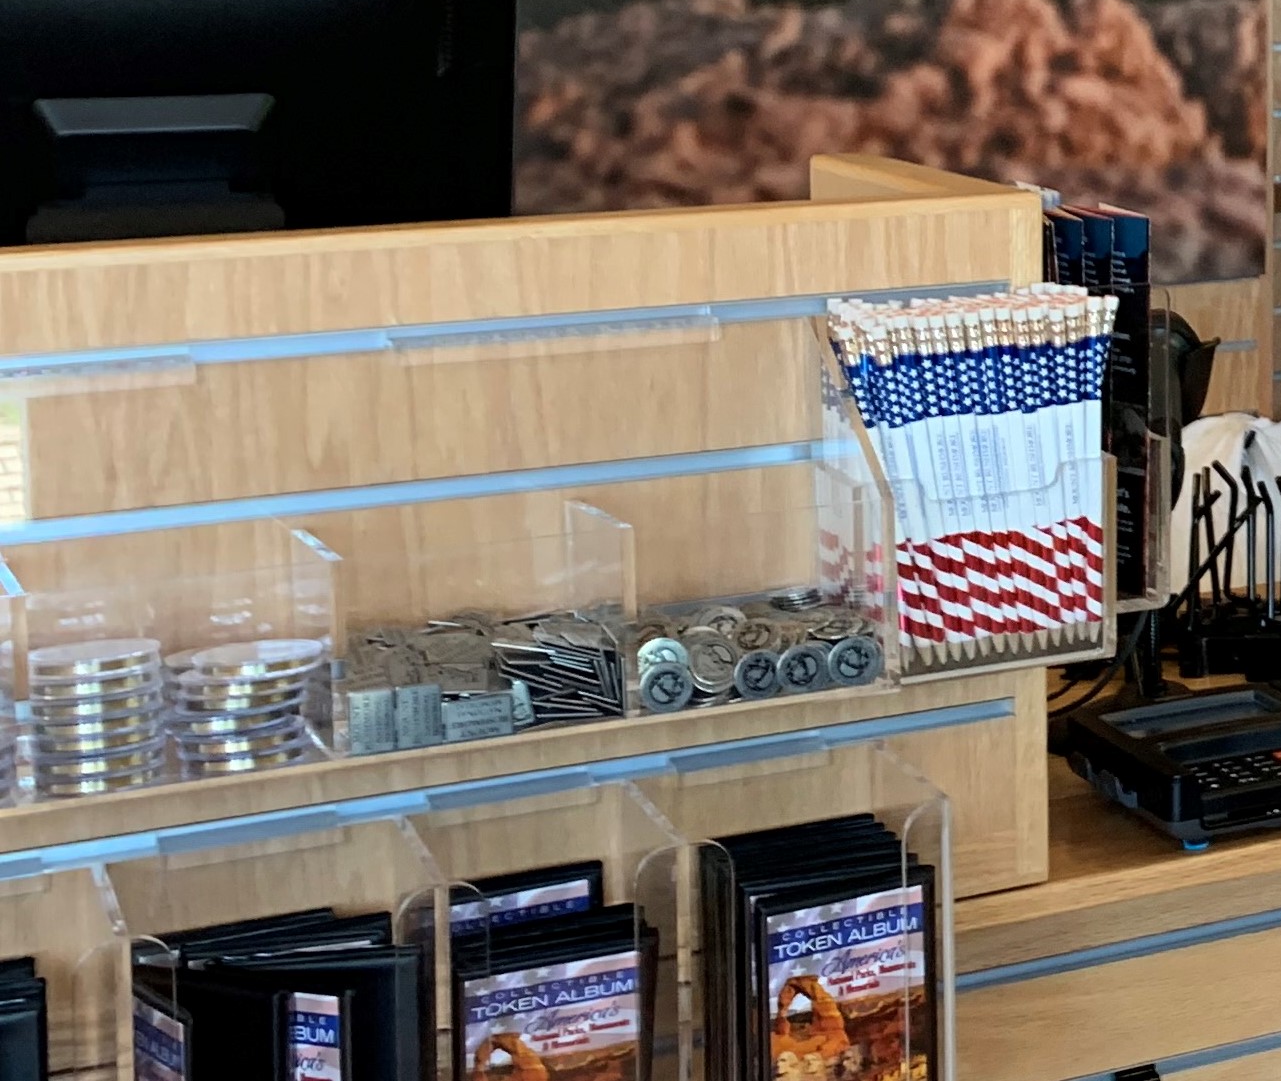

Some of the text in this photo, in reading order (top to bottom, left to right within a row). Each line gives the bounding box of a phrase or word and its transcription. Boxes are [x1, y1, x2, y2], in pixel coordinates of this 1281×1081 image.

[773, 916, 918, 959] TOKEN ALBUM
[781, 906, 910, 942] COLLECTIBLE
[821, 940, 906, 977] America's
[471, 979, 634, 1020] TOKEN ALBUM
[481, 971, 625, 1005] COLLECTIBLE
[524, 1000, 621, 1036] America's
